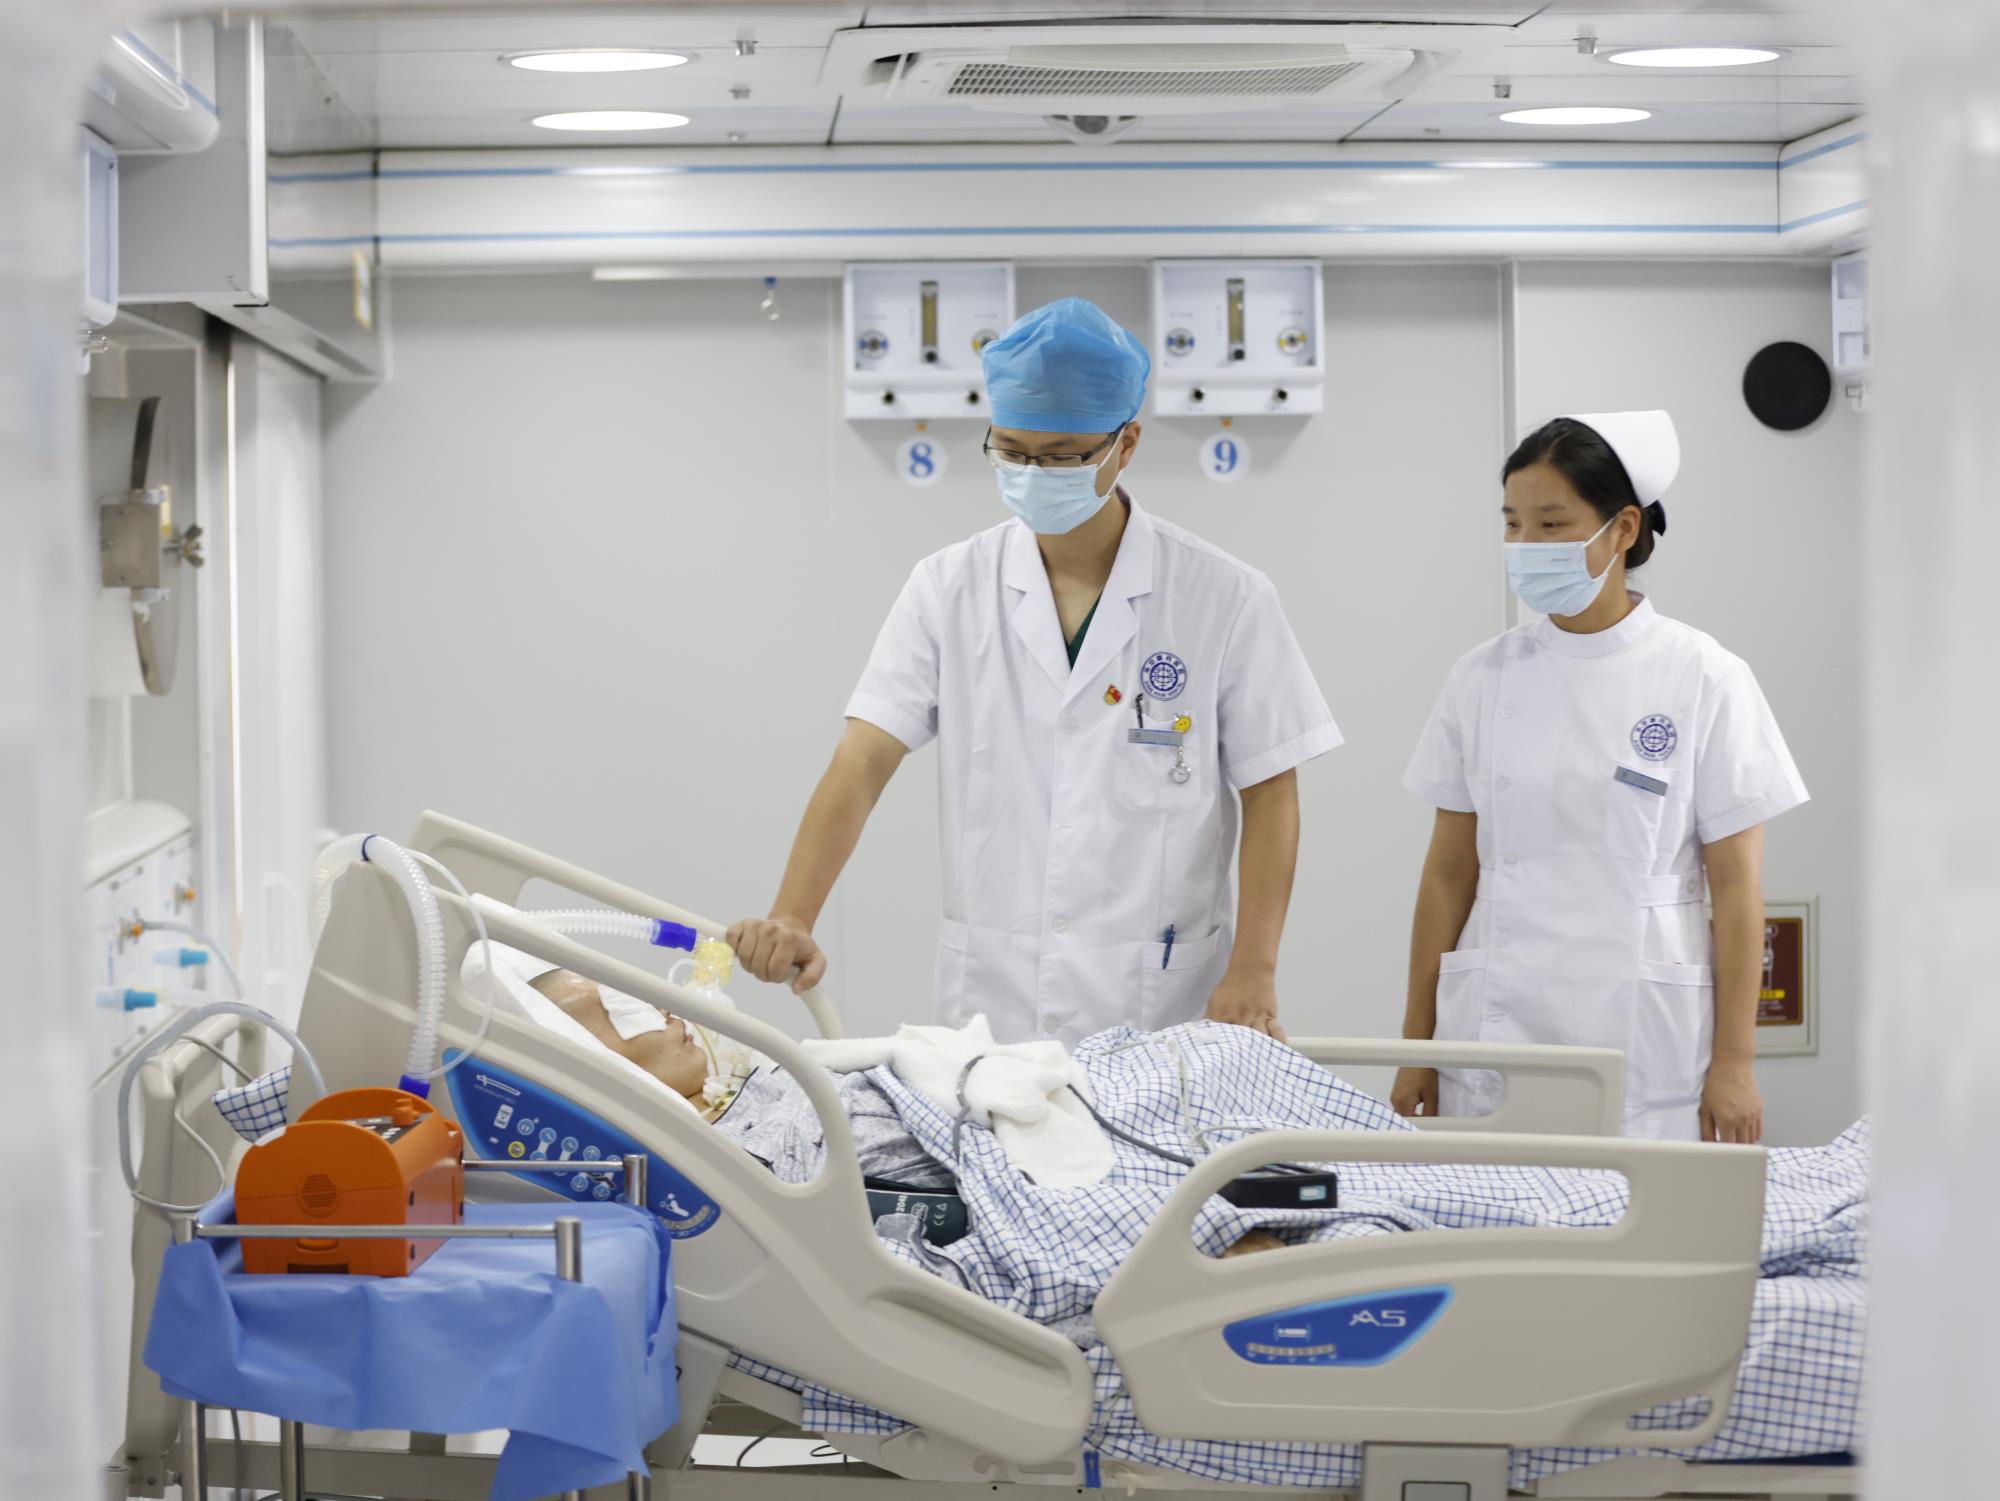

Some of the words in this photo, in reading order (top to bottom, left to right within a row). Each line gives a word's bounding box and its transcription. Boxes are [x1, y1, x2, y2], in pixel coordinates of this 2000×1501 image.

[910, 441, 934, 479] 8
[1213, 438, 1238, 475] 9
[1349, 1309, 1407, 1328] A5
